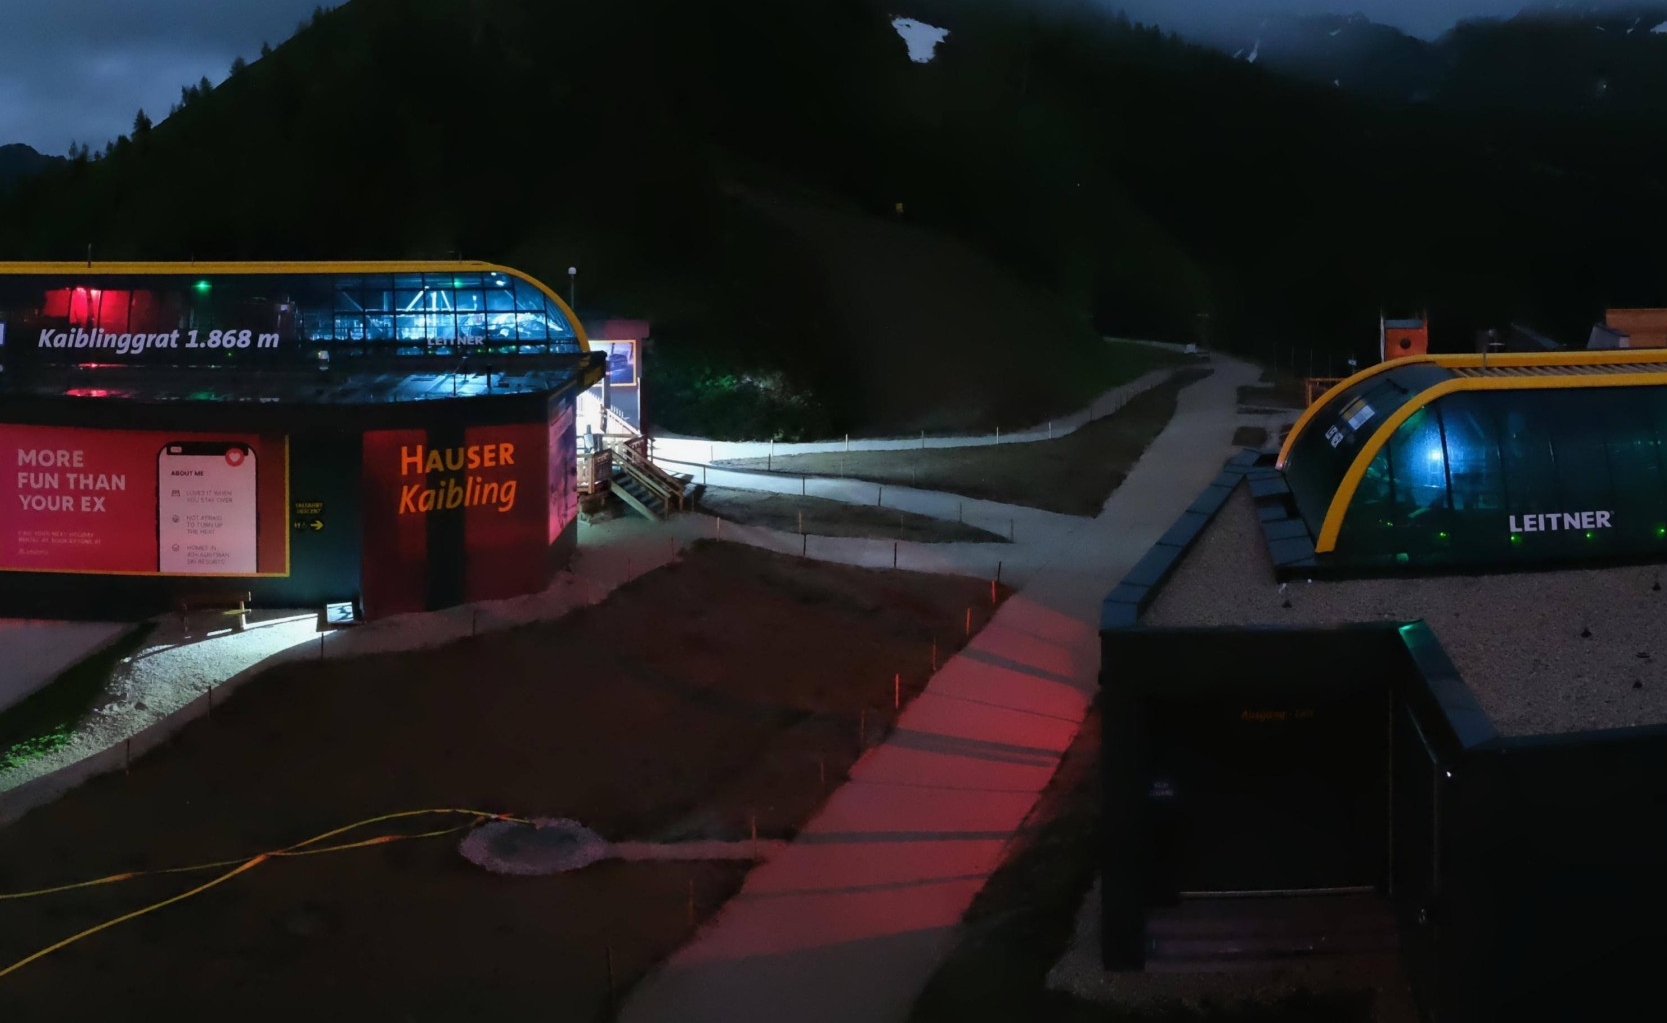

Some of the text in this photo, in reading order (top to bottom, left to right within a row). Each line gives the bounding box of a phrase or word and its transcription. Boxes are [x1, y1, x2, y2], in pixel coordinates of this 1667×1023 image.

[38, 328, 280, 354] Kaiblinggrat 1.868 m
[17, 449, 84, 467] MORE
[401, 442, 515, 475] HAUSER
[17, 472, 126, 491] FUN THAN
[19, 494, 106, 512] YOUR EX
[399, 477, 517, 514] Kaibling
[1509, 511, 1612, 533] LEITNER
